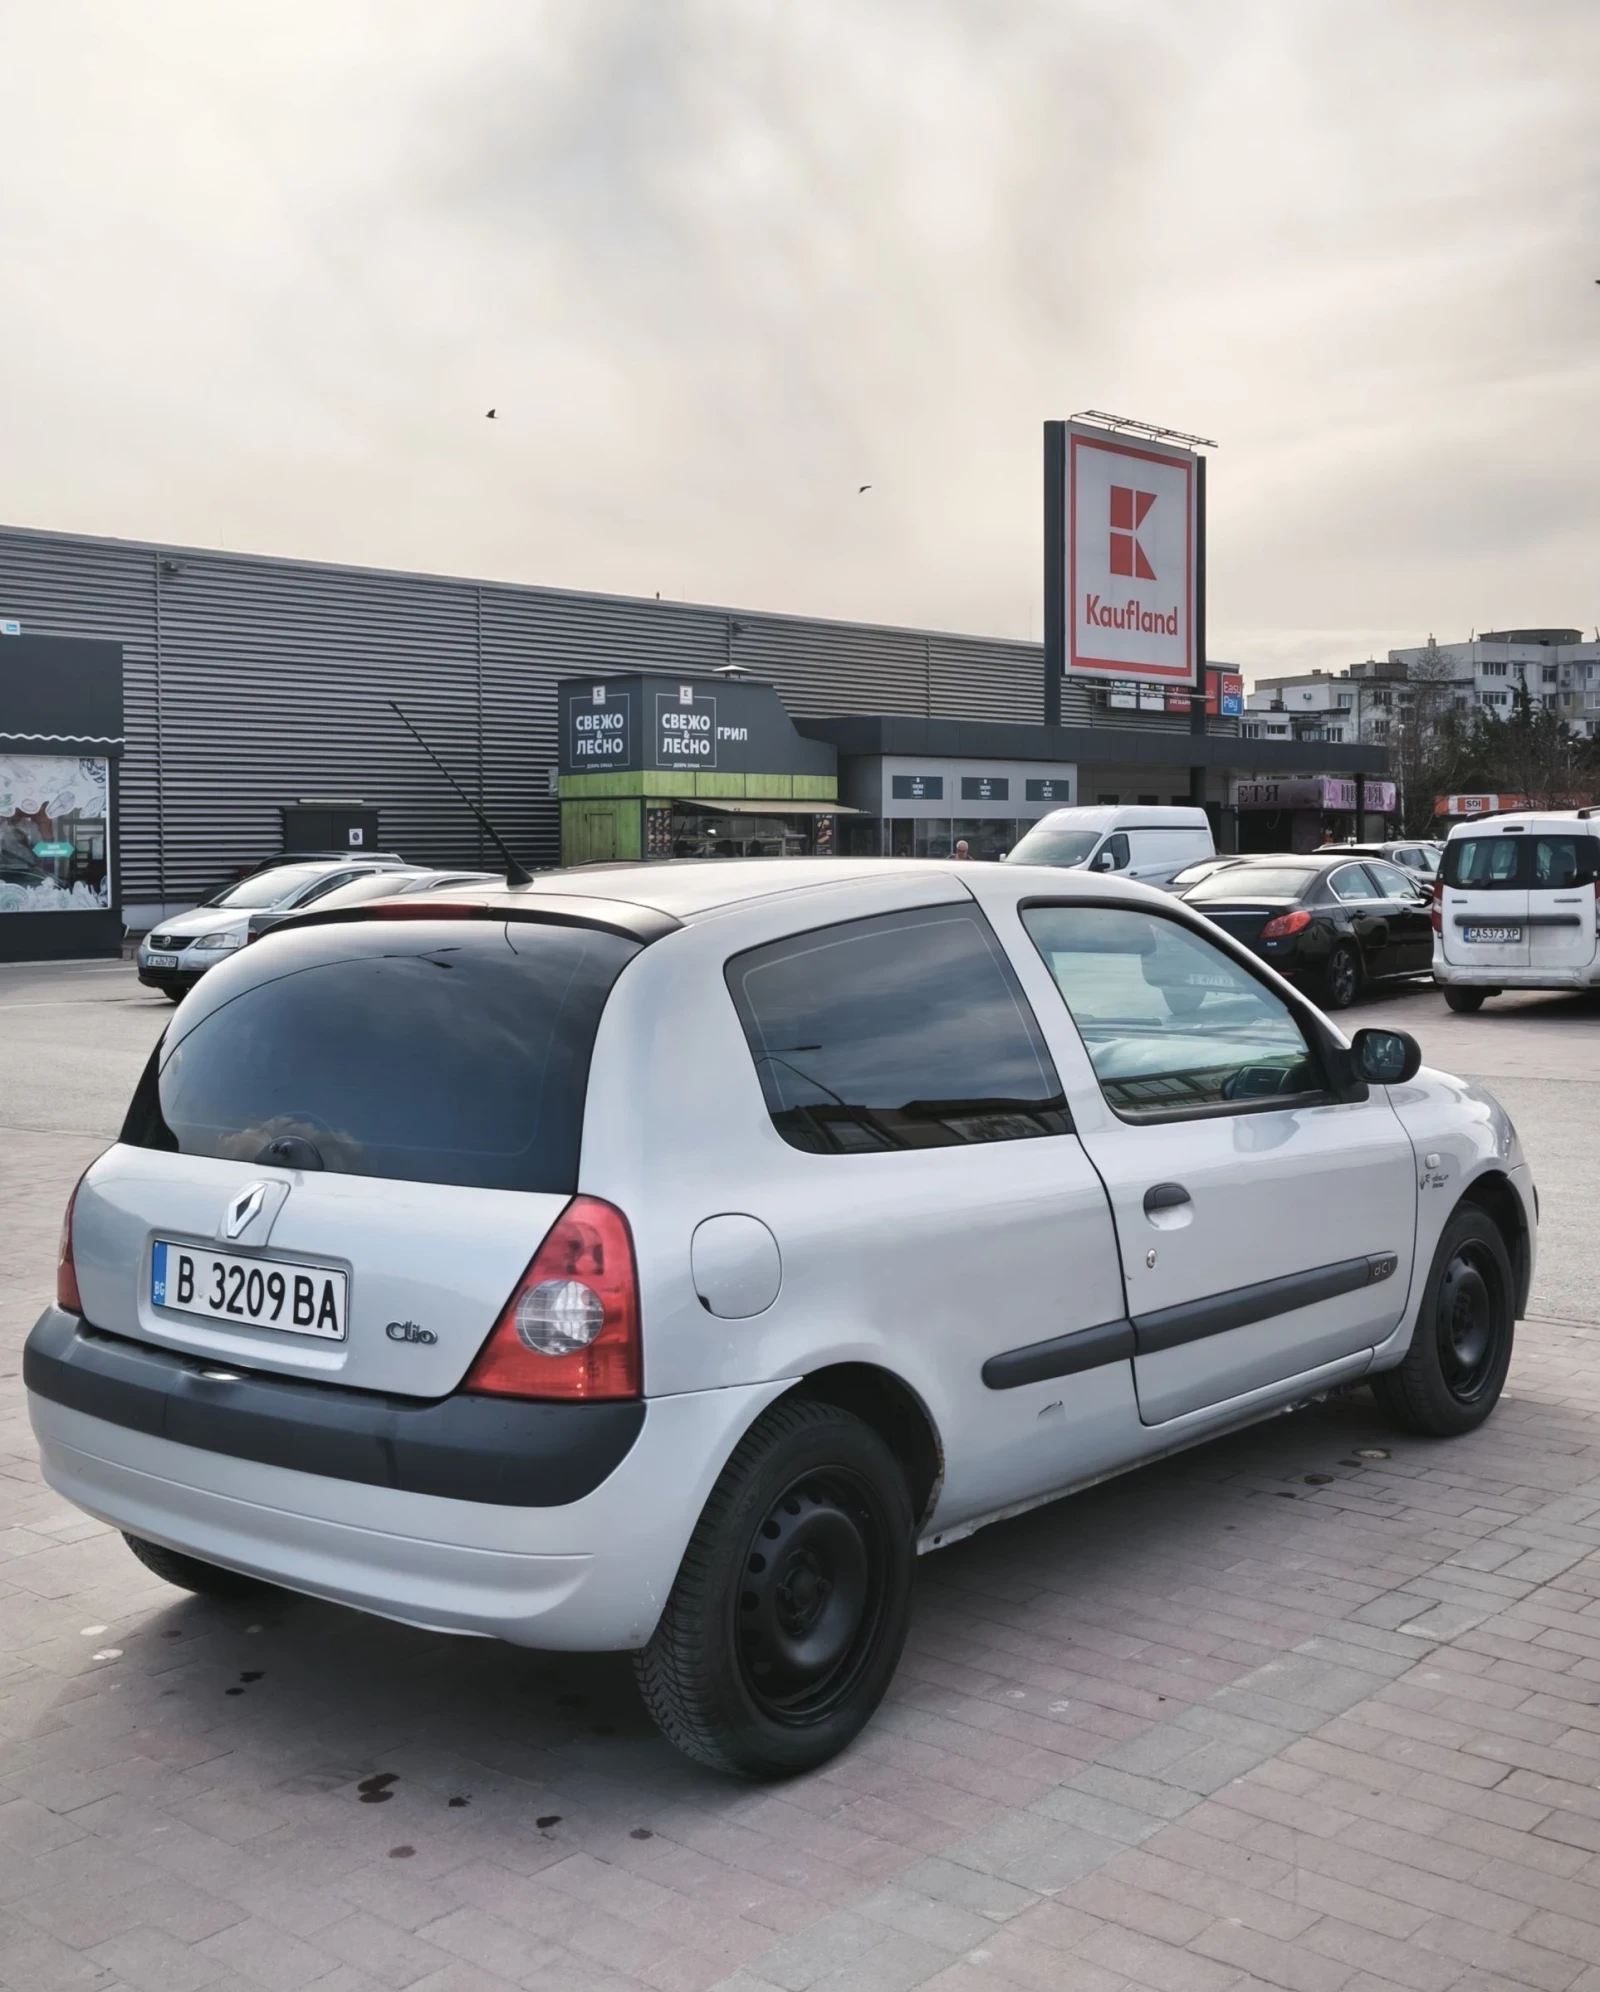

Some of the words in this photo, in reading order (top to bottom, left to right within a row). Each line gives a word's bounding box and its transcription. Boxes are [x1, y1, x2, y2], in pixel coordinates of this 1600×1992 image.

[1086, 594, 1178, 636] Kaufland
[1223, 680, 1242, 697] Easy
[1223, 696, 1238, 711] Pay
[576, 713, 624, 731] СВЕЖО
[662, 713, 710, 730] СВЕЖО
[596, 730, 603, 739] &
[683, 730, 690, 739] &
[717, 726, 748, 741] ГРИЛ
[576, 738, 624, 755] ЛЕСНО
[662, 738, 710, 755] ЛЕСНО
[1466, 800, 1481, 808] SDI
[154, 1281, 166, 1297] BG
[176, 1255, 195, 1304] B
[208, 1262, 286, 1321] 3209
[292, 1275, 339, 1331] BA
[386, 1320, 438, 1345] Clio
